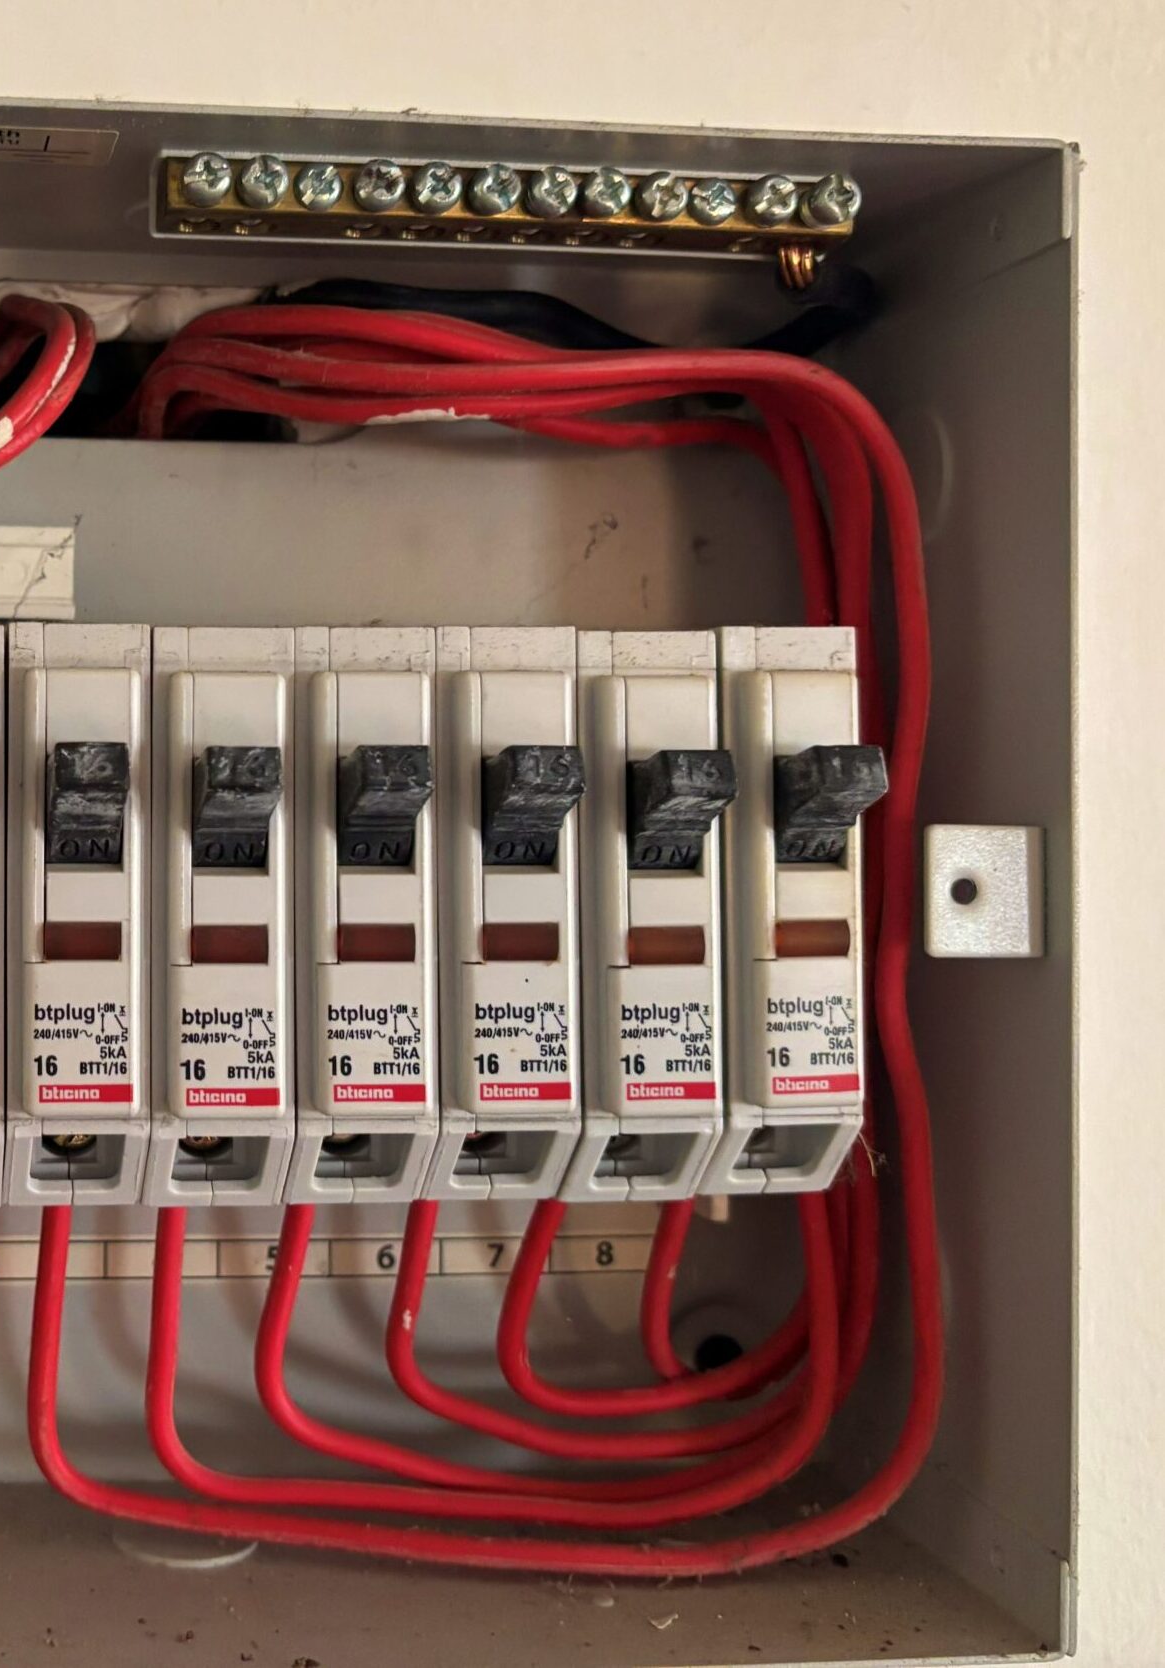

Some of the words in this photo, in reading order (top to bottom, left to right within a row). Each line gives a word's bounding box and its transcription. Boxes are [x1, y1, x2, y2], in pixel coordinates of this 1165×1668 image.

[60, 838, 110, 859] ON
[204, 841, 255, 862] ON
[349, 840, 402, 862] ON
[494, 840, 546, 861] ON
[640, 844, 692, 865] ON
[785, 840, 836, 859] ON
[34, 1003, 95, 1024] btplug
[327, 1004, 388, 1025] btplug
[474, 1003, 535, 1023] btplug
[621, 1004, 680, 1024] btplug
[767, 998, 823, 1017] btplug
[181, 1008, 243, 1029] btplug
[540, 1044, 567, 1057] 5kA
[684, 1044, 711, 1056] 5kA
[828, 1036, 854, 1049] 5kA
[99, 1047, 127, 1059] 5kA
[247, 1052, 274, 1064] 5kA
[393, 1047, 420, 1059] 5kA
[767, 1047, 791, 1067] 16
[810, 1052, 854, 1065] BTT1/16
[33, 1055, 58, 1076] 16
[79, 1062, 128, 1075] BTT1/16
[180, 1059, 206, 1080] 16
[227, 1066, 275, 1080] BTT1/16
[328, 1055, 352, 1076] 16
[373, 1062, 420, 1076] BTT1/16
[473, 1053, 499, 1075] 16
[520, 1059, 567, 1073] BTT1/16
[620, 1053, 645, 1075] 16
[665, 1059, 711, 1073] BTT1/16
[42, 1087, 100, 1100] bticino
[336, 1086, 394, 1099] bticino
[483, 1085, 539, 1098] bticino
[629, 1084, 684, 1098] bticino
[775, 1079, 830, 1092] bticino
[189, 1090, 246, 1104] bticino
[376, 1244, 395, 1269] 6
[487, 1243, 505, 1268] 7
[595, 1241, 614, 1265] 8
